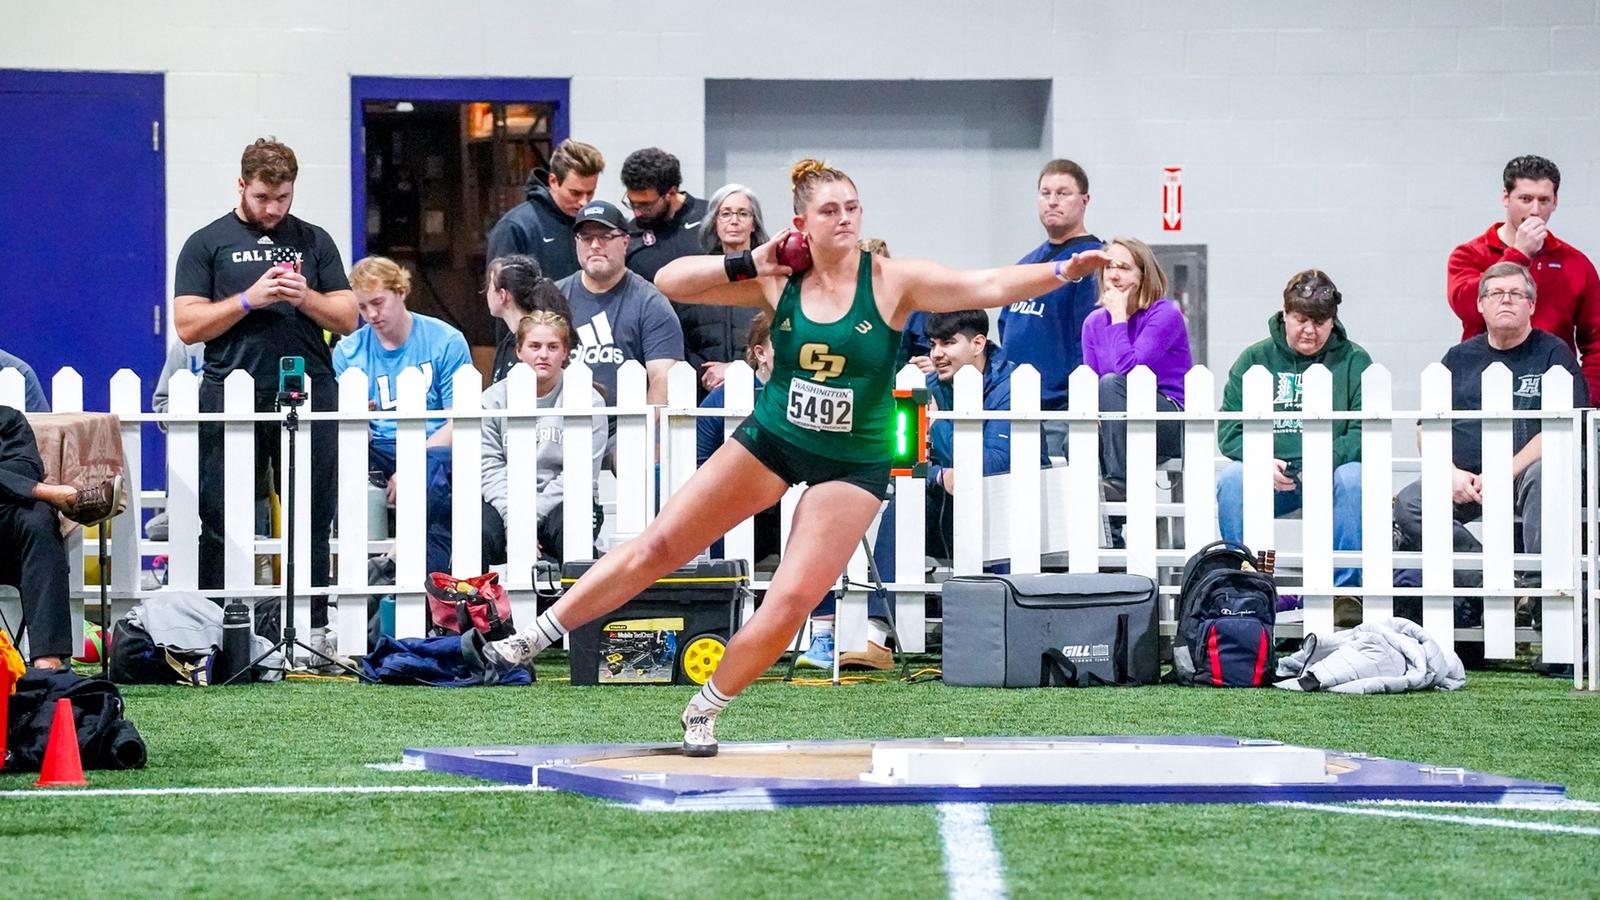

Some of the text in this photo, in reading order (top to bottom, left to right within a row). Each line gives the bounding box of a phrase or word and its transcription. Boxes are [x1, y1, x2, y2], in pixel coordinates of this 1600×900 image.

[232, 250, 263, 263] CAL
[794, 381, 849, 399] WASHINGTON
[789, 391, 852, 425] 5492
[1062, 645, 1091, 657] GILL
[690, 715, 709, 725] NIKE
